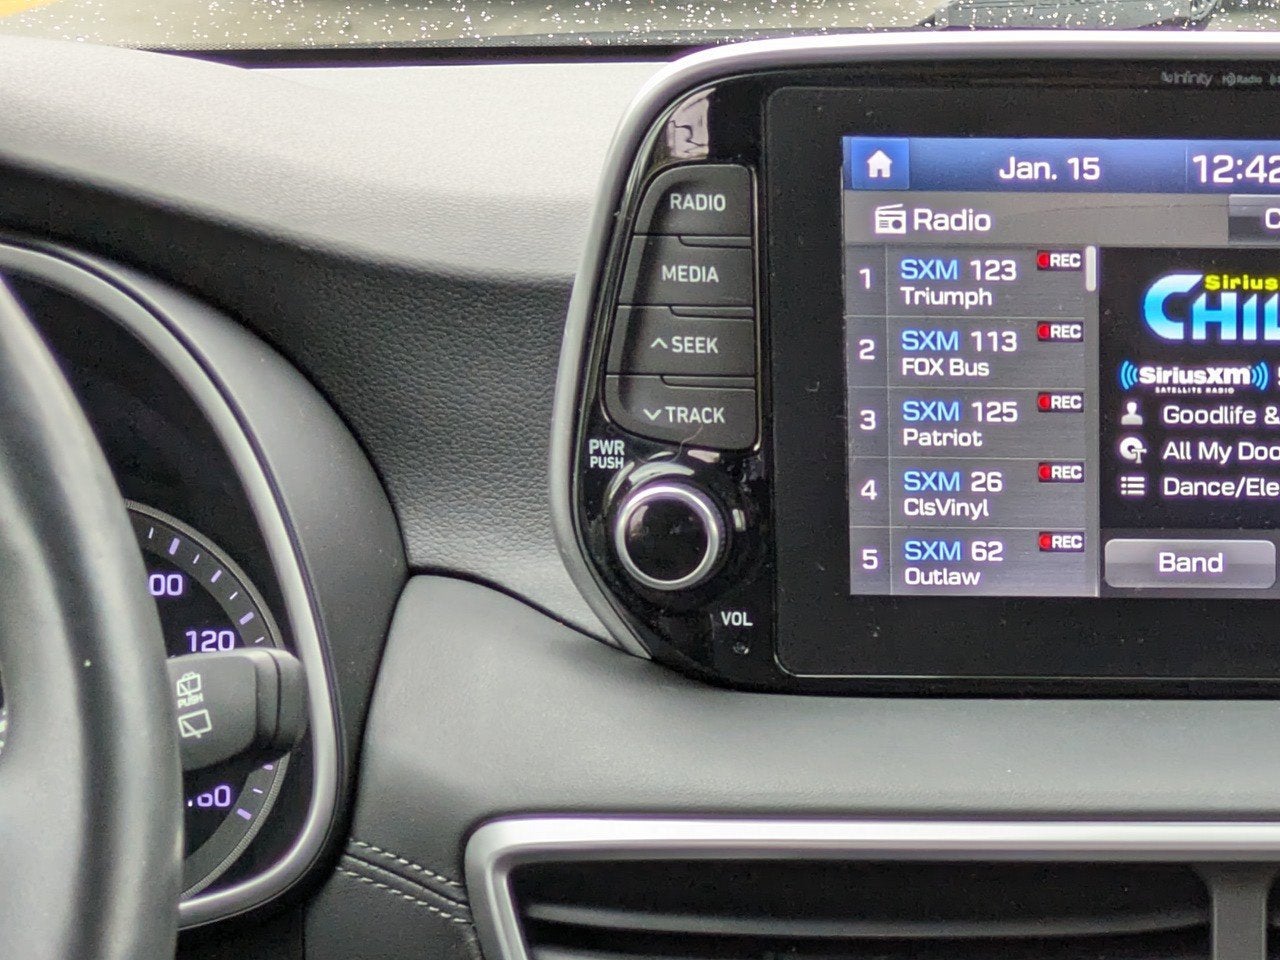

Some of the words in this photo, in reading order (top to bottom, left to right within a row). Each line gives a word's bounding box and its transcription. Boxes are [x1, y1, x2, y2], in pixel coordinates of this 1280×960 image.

[999, 156, 1058, 180] Jan.
[1067, 156, 1100, 180] 15
[670, 193, 726, 212] RADIO
[913, 207, 992, 232] Radio
[900, 258, 958, 280] SXM
[970, 259, 1017, 281] 123
[1049, 253, 1081, 268] REC
[662, 264, 719, 283] MEDIA
[859, 268, 871, 290] 1
[899, 286, 993, 310] Triumph
[901, 329, 959, 351] SXM
[970, 330, 1018, 352] 113
[1050, 324, 1082, 339] REC
[671, 335, 719, 354] SEEK
[859, 338, 876, 360] 2
[902, 357, 944, 376] FOX
[949, 357, 990, 377] Bus
[1205, 386, 1235, 395] RADIO
[902, 400, 960, 422] SXM
[971, 401, 1019, 423] 125
[1050, 394, 1082, 410] REC
[664, 405, 725, 424] TRACK
[860, 409, 877, 431] 3
[1163, 405, 1257, 425] Goodlife
[588, 439, 625, 456] PWR
[903, 427, 983, 447] Patriot
[589, 456, 625, 470] PUSH
[1162, 441, 1192, 461] All
[1198, 441, 1233, 465] My
[903, 470, 961, 492] SXM
[970, 471, 1003, 493] 26
[1051, 464, 1083, 480] REC
[860, 479, 878, 501] 4
[903, 497, 990, 521] ClsVinyl
[904, 540, 961, 561] SXM
[971, 540, 1004, 562] 62
[1051, 534, 1083, 549] REC
[862, 548, 879, 570] 5
[1158, 551, 1224, 573] Band
[148, 573, 184, 596] 00
[904, 566, 982, 586] Outlaw
[720, 611, 754, 627] VOL
[186, 630, 235, 653] 120
